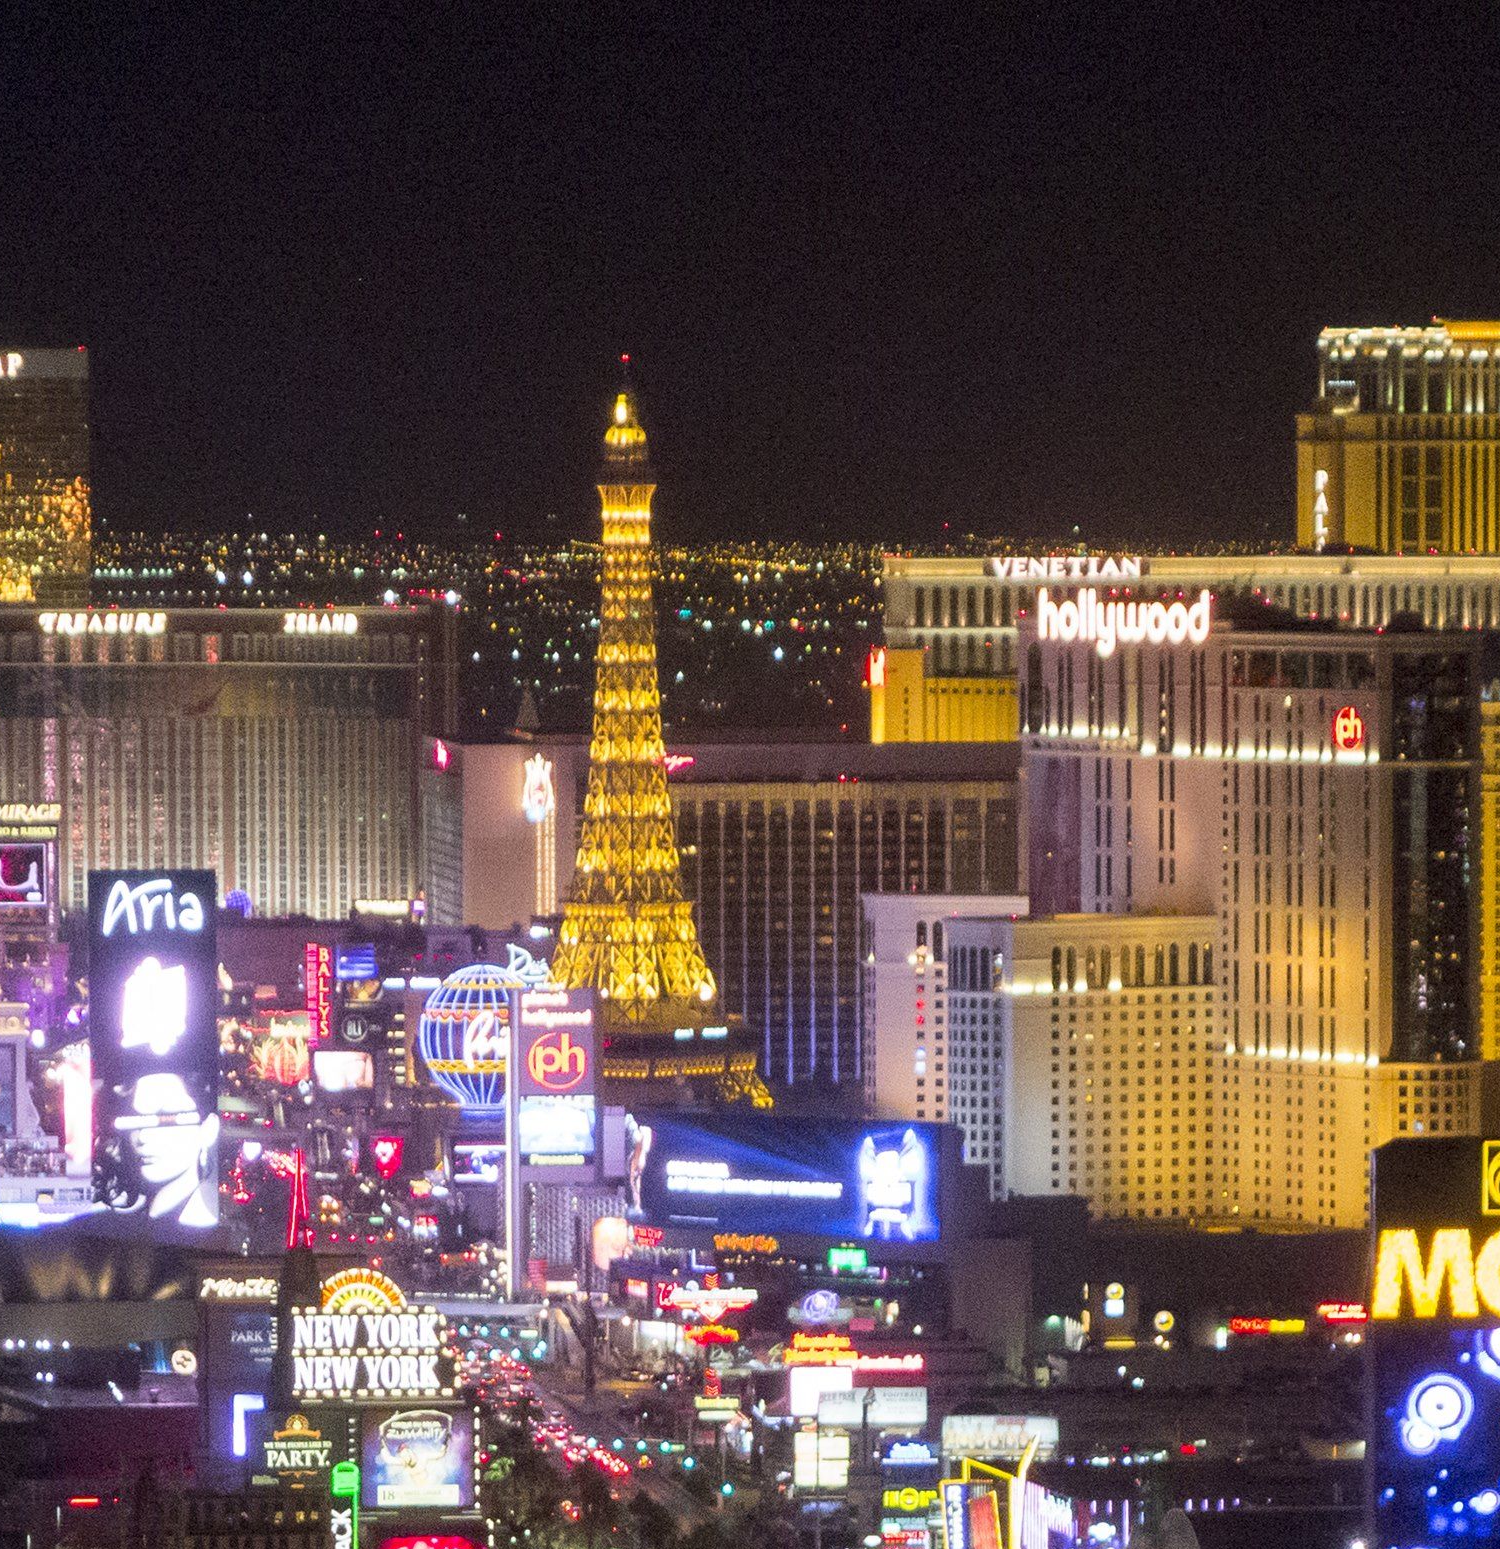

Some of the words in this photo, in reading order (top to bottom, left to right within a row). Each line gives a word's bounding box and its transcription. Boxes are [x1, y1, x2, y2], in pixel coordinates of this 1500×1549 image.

[991, 556, 1142, 579] VENETIAN
[39, 612, 168, 635] TREASURE
[1037, 587, 1210, 658] hollywood
[103, 878, 205, 937] Aria
[532, 1032, 586, 1085] ph
[231, 1330, 263, 1343] PARK
[293, 1314, 357, 1348] NEW
[363, 1314, 439, 1348] YORK
[293, 1355, 357, 1389] NEW
[363, 1355, 440, 1389] YORK
[266, 1449, 331, 1468] PARTY.
